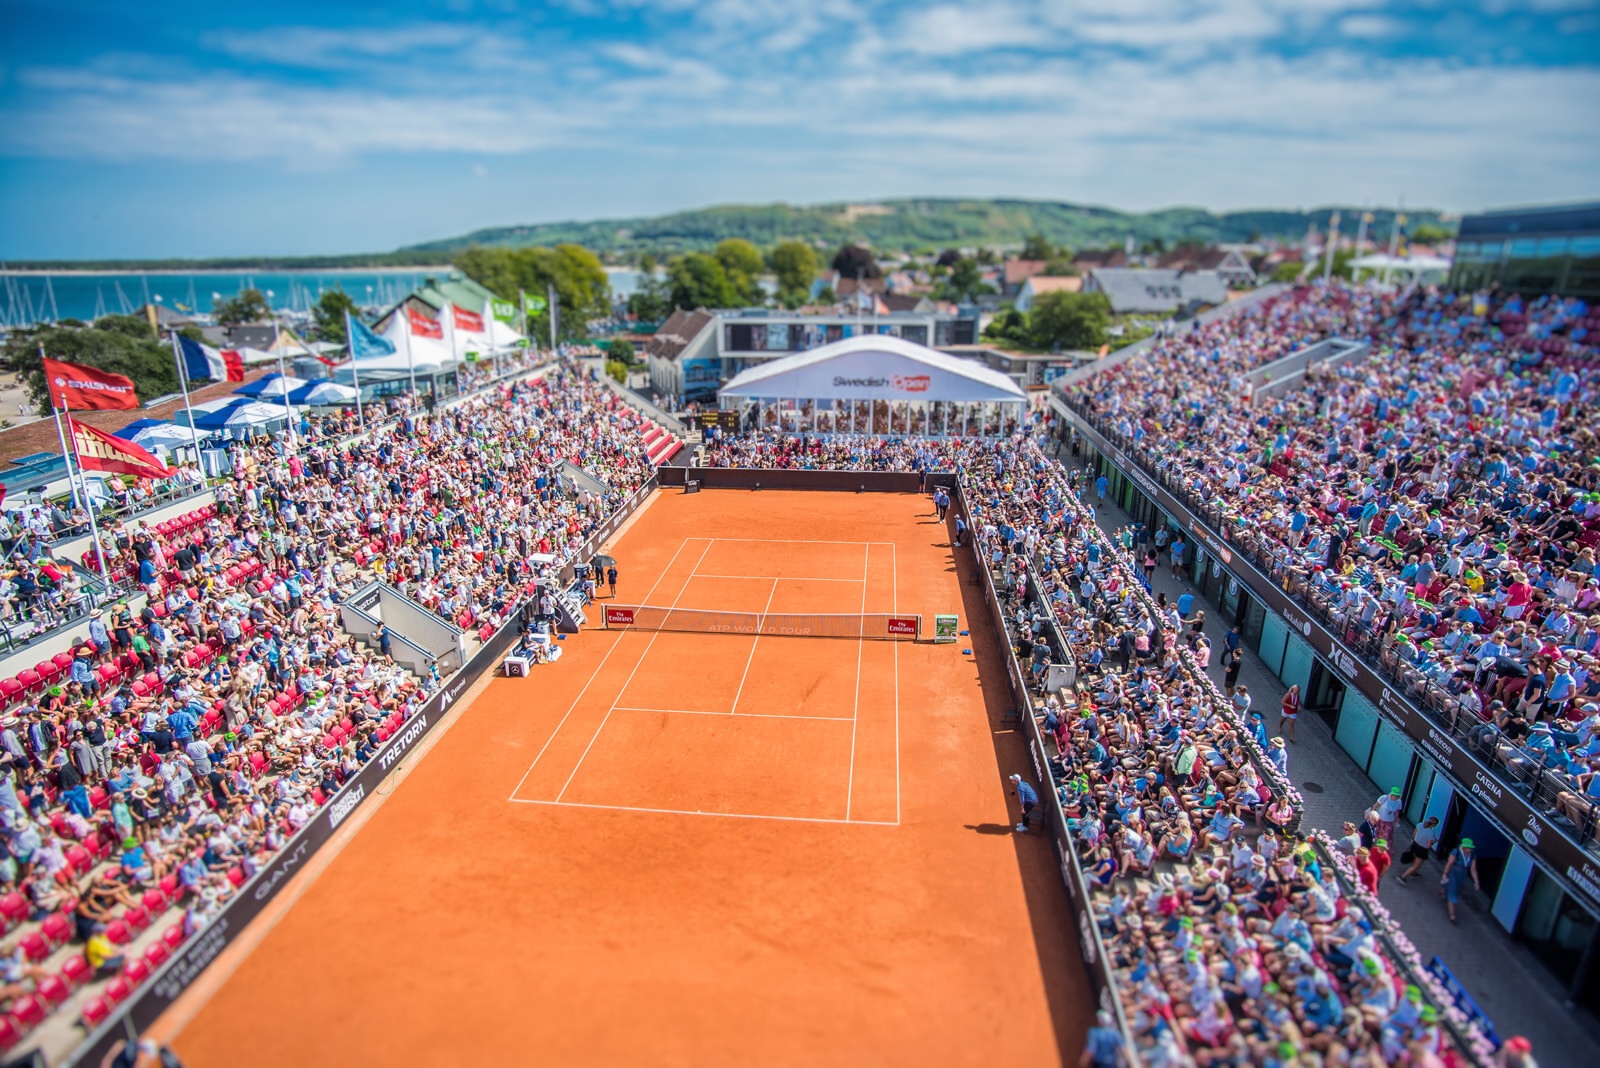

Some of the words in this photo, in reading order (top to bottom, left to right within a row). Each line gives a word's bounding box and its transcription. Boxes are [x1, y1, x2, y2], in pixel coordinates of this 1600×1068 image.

[833, 376, 889, 387] Swedish
[890, 374, 931, 391] Open
[608, 615, 633, 623] Emirates
[889, 625, 914, 633] Emirates
[780, 627, 810, 635] TOUR
[379, 715, 428, 770] TRETORN
[1434, 733, 1453, 753] Brinova
[1421, 739, 1453, 770] KUNGSLEDEN
[1476, 771, 1502, 798] CATENA
[255, 839, 309, 900] GANT
